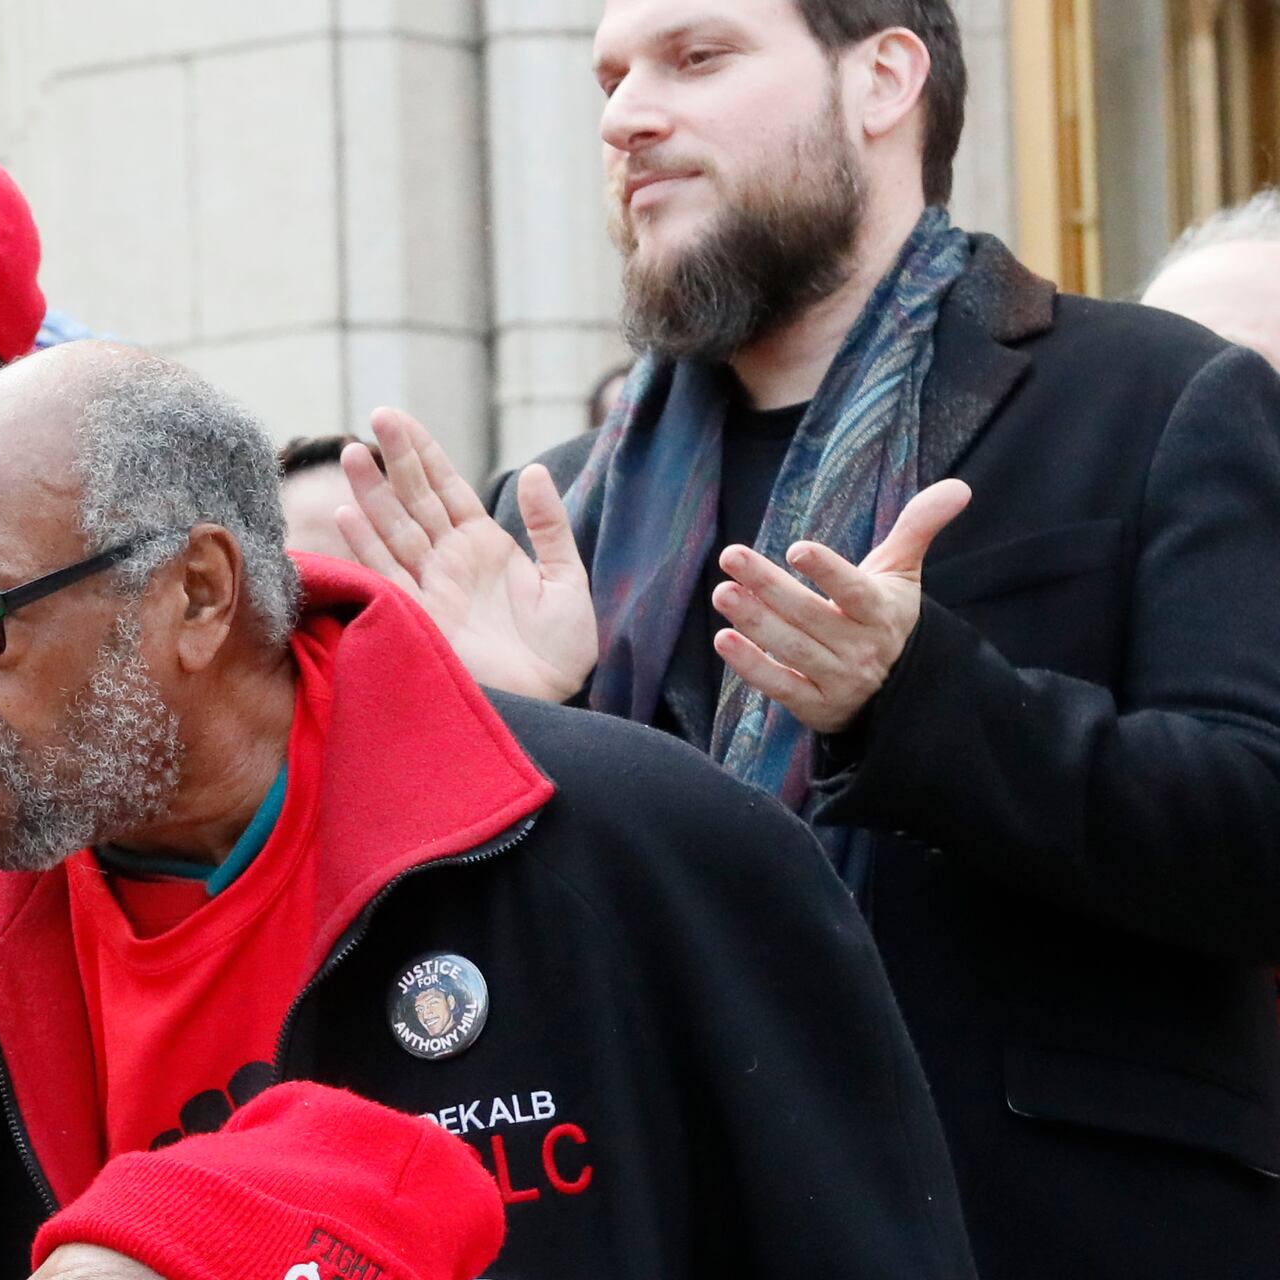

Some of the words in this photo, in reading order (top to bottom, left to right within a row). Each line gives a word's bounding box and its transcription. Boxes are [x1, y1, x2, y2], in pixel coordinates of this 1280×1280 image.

[397, 960, 462, 995] JUSTICE
[394, 1021, 460, 1052] ANTHONY
[457, 999, 477, 1037] HILL
